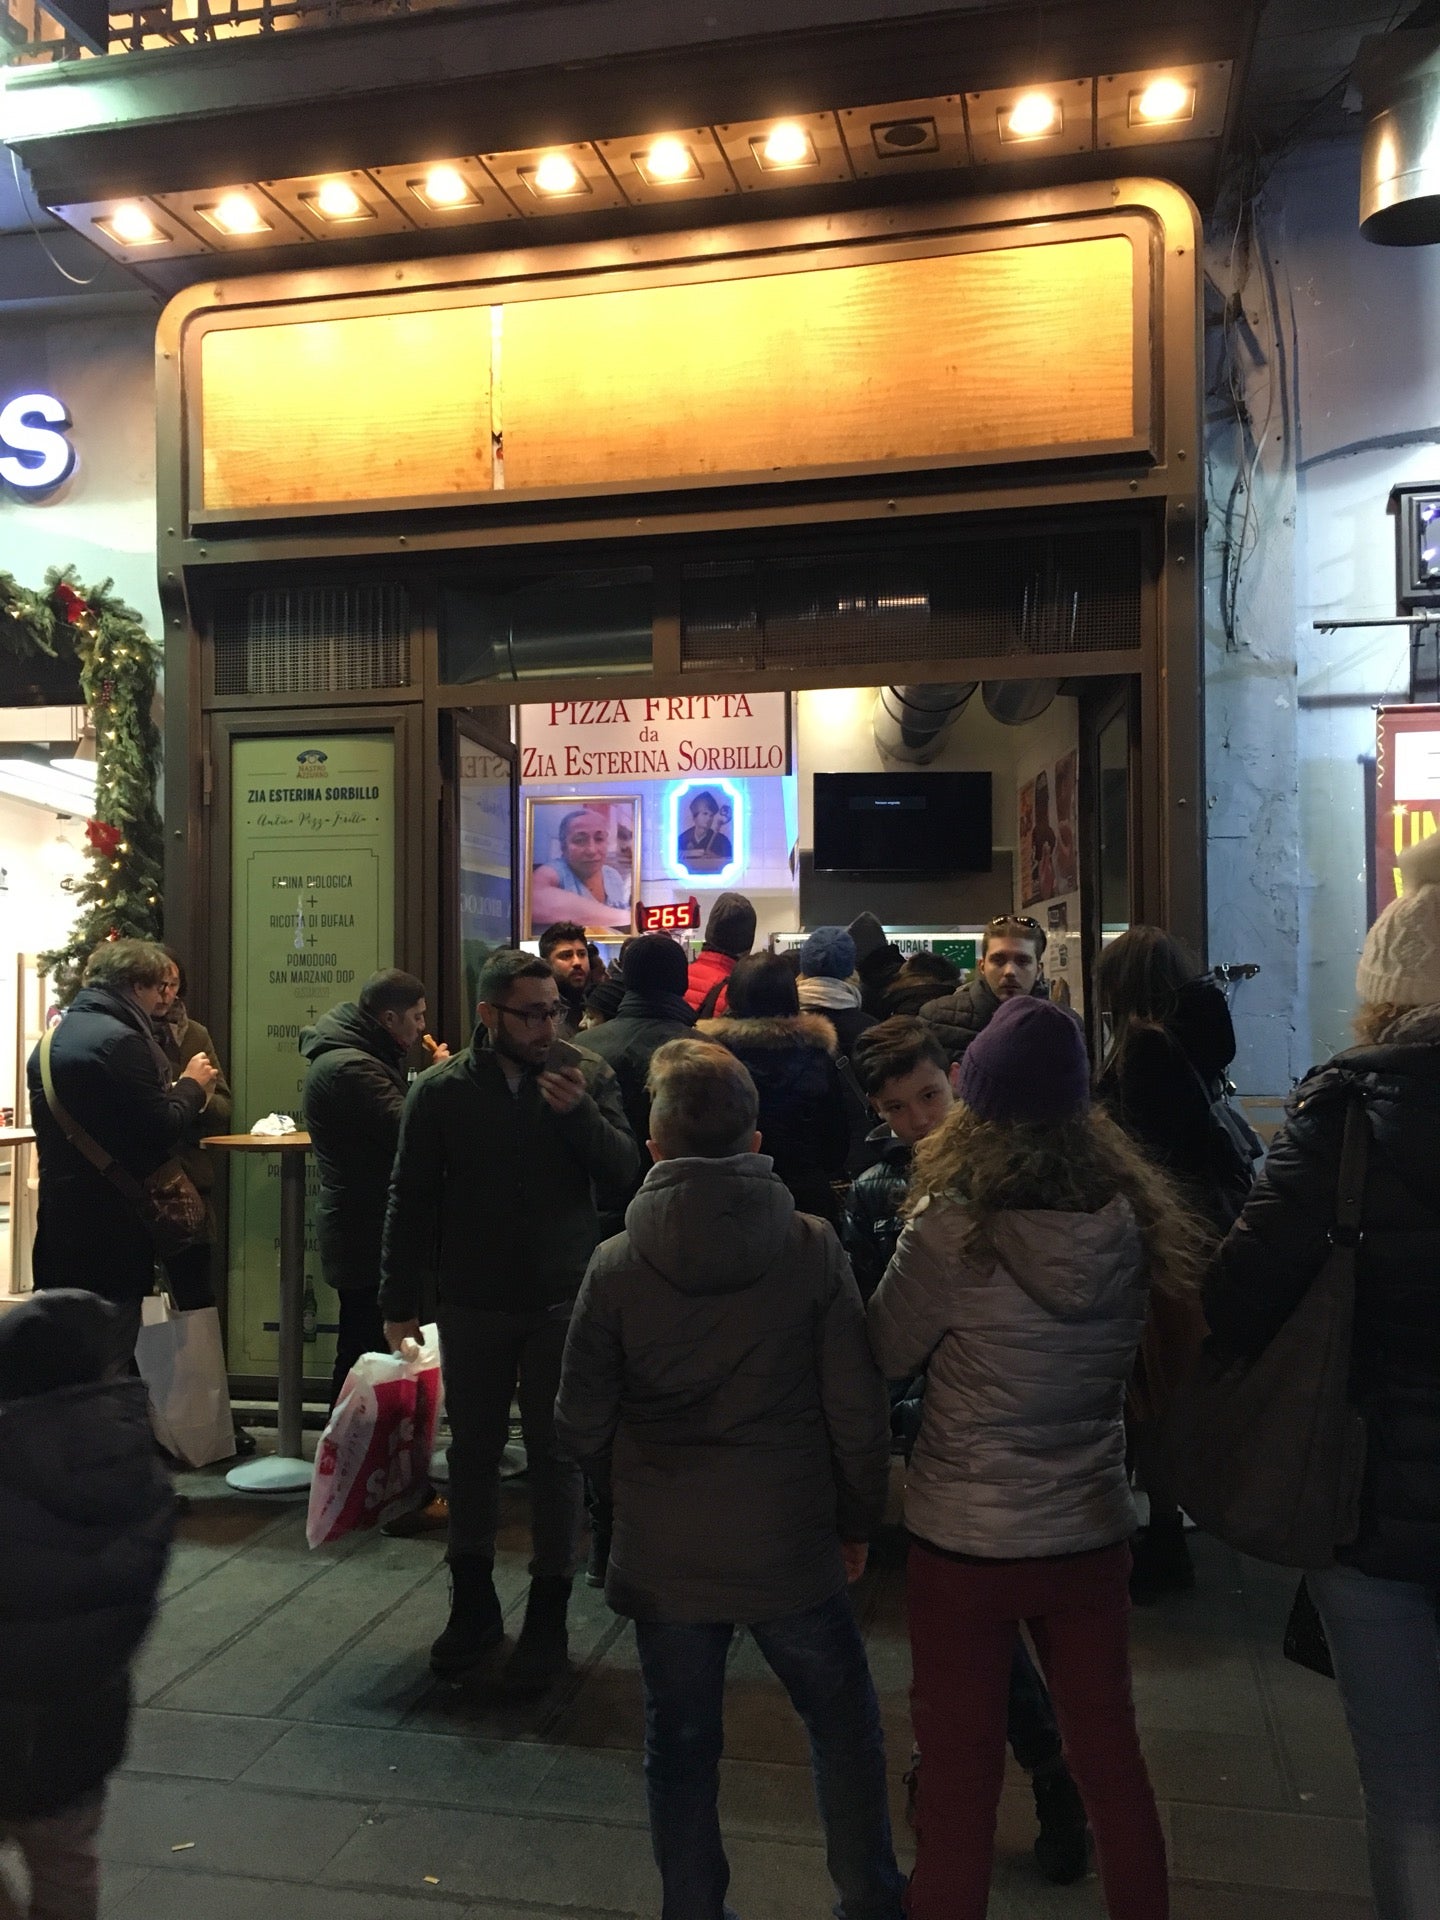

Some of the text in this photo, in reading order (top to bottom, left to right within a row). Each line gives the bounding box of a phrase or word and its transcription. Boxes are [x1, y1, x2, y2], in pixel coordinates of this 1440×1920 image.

[0, 393, 59, 488] S
[548, 694, 754, 726] PIZZA FRITTA
[639, 726, 659, 742] da
[248, 786, 379, 803] ZIA ESTERINA SORBILLO
[309, 915, 318, 928] DI
[321, 914, 354, 928] BUFALA
[647, 905, 690, 928] 265
[287, 953, 337, 967] POMODORO
[269, 970, 355, 984] SAN MARZANO DOP
